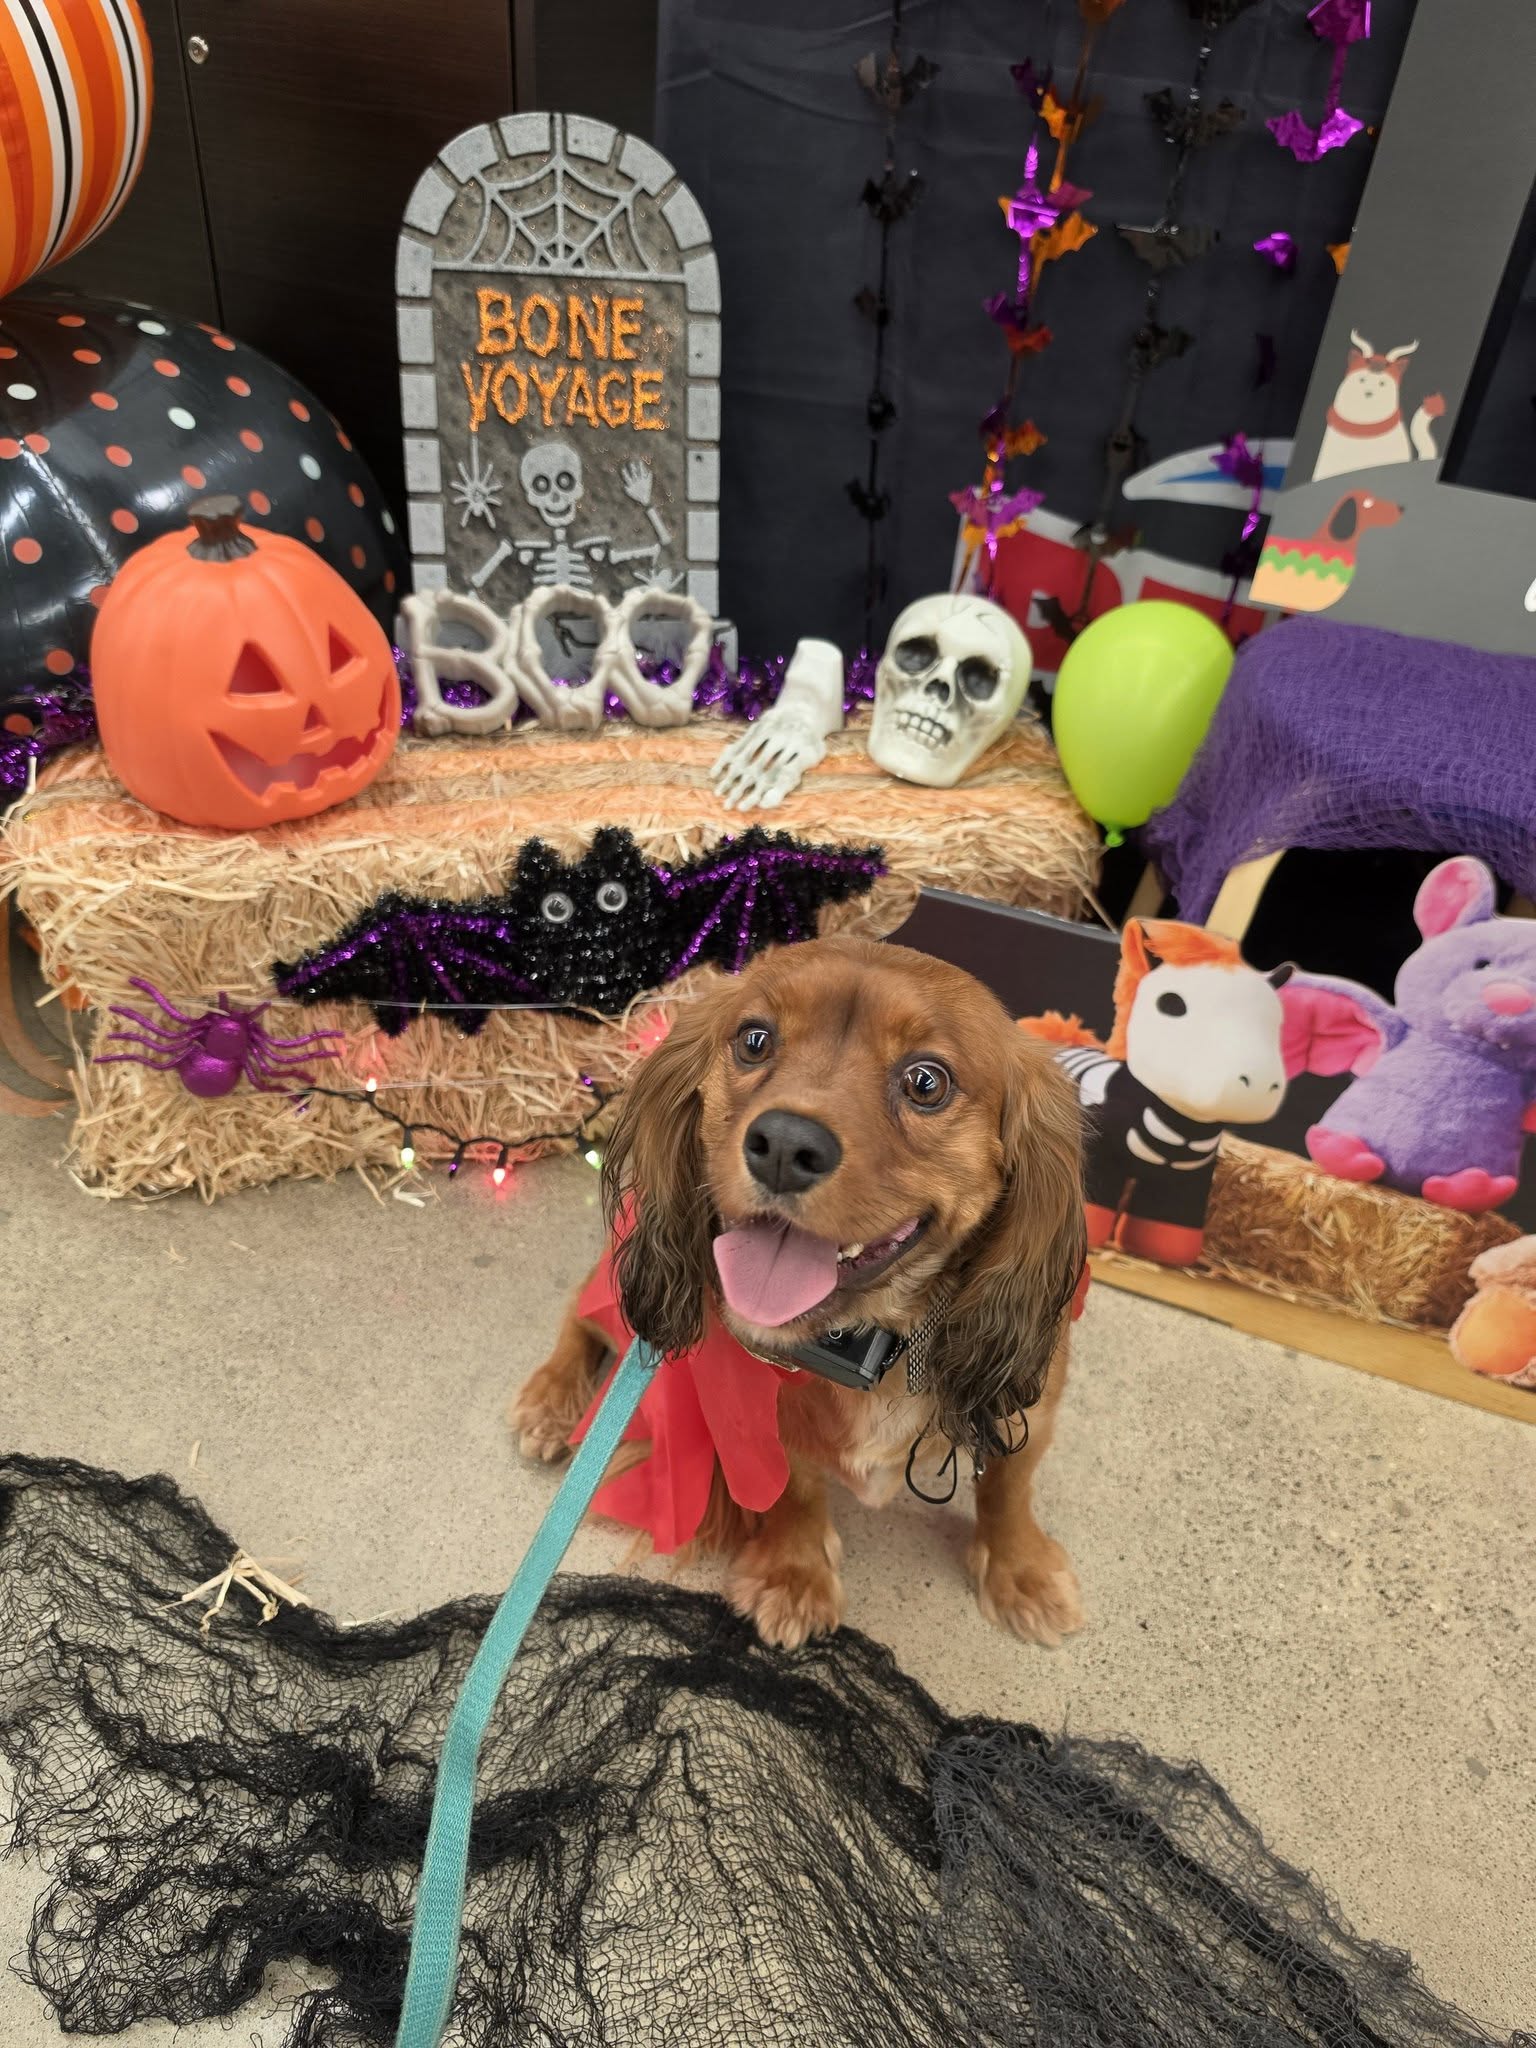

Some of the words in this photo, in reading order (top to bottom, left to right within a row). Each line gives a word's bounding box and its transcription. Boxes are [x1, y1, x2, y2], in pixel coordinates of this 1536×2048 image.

[476, 287, 644, 361] BONE
[461, 360, 667, 432] VOYAGE
[401, 584, 712, 736] BOO
